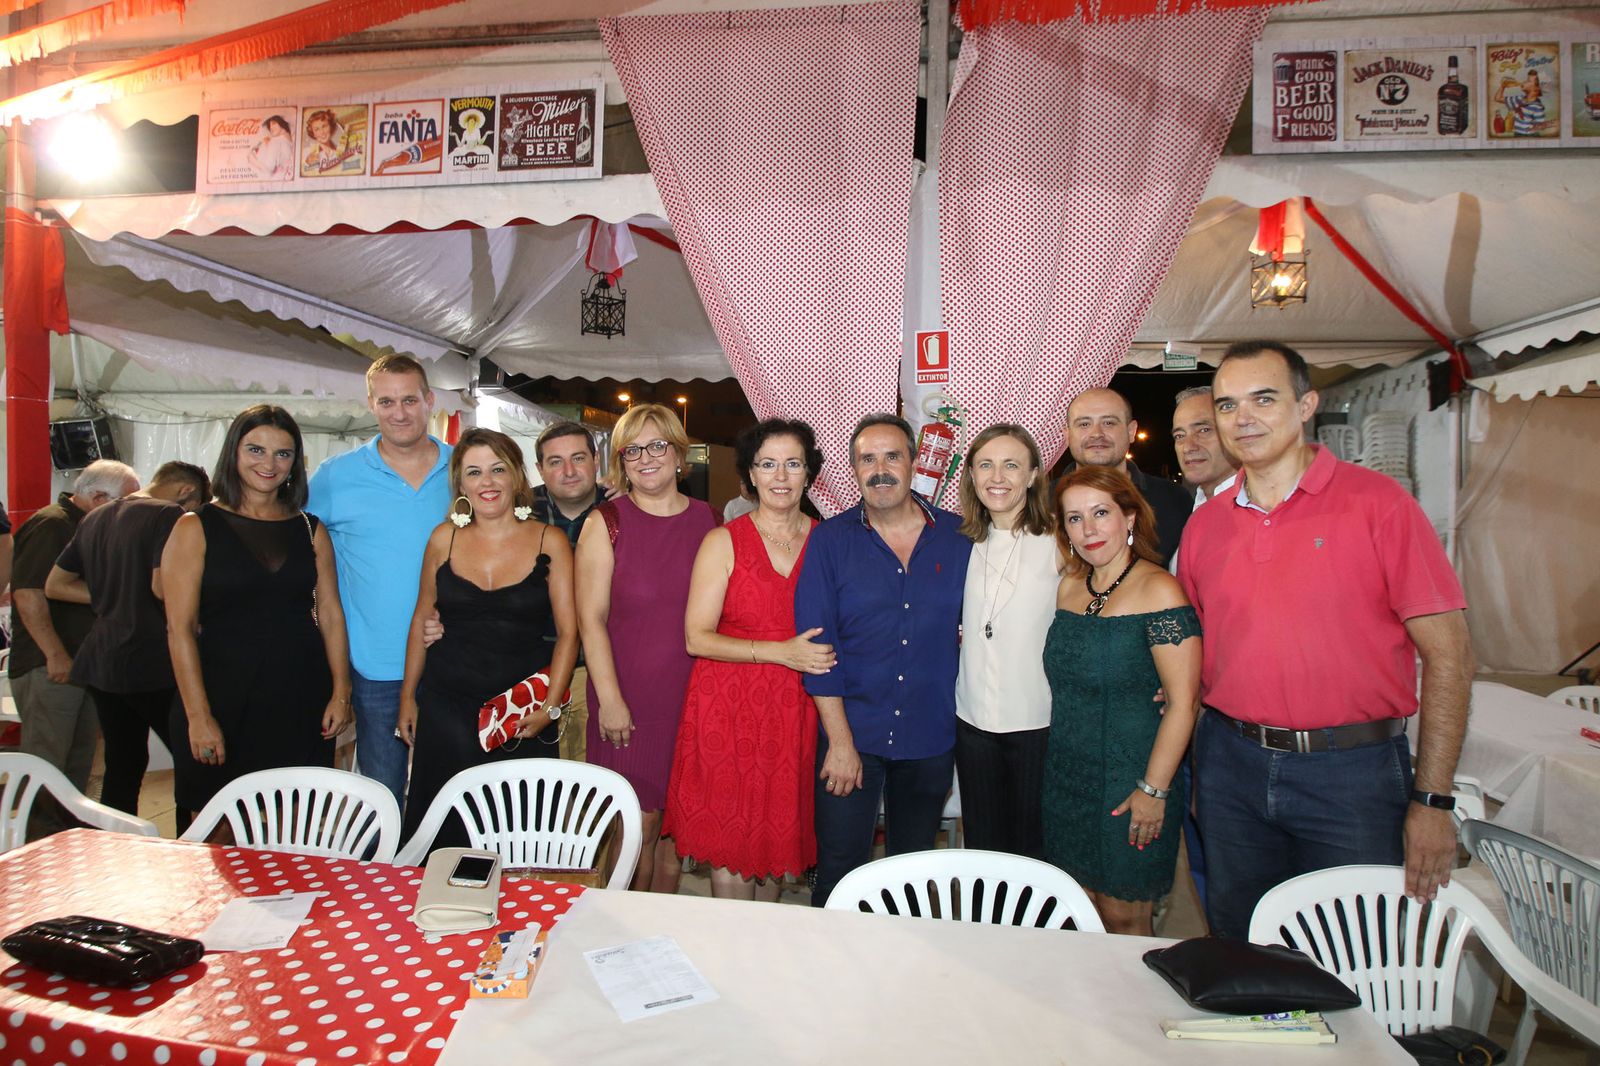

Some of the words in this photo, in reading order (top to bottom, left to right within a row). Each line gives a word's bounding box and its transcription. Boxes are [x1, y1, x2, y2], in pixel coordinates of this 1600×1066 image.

[1295, 58, 1325, 70] DRINK
[1353, 61, 1384, 83] JACK
[1295, 71, 1334, 83] GOOD
[1276, 82, 1335, 108] BEER
[450, 97, 495, 112] VERMOUTH
[531, 97, 587, 124] Miller
[1293, 104, 1334, 122] GOOD
[379, 116, 438, 144] FANTA
[525, 122, 550, 138] HIGH
[553, 120, 576, 137] LIFE
[1277, 115, 1336, 140] FRIENDS
[526, 143, 568, 156] BEER
[454, 154, 488, 166] MARTINI
[918, 373, 948, 382] EXTINTOR
